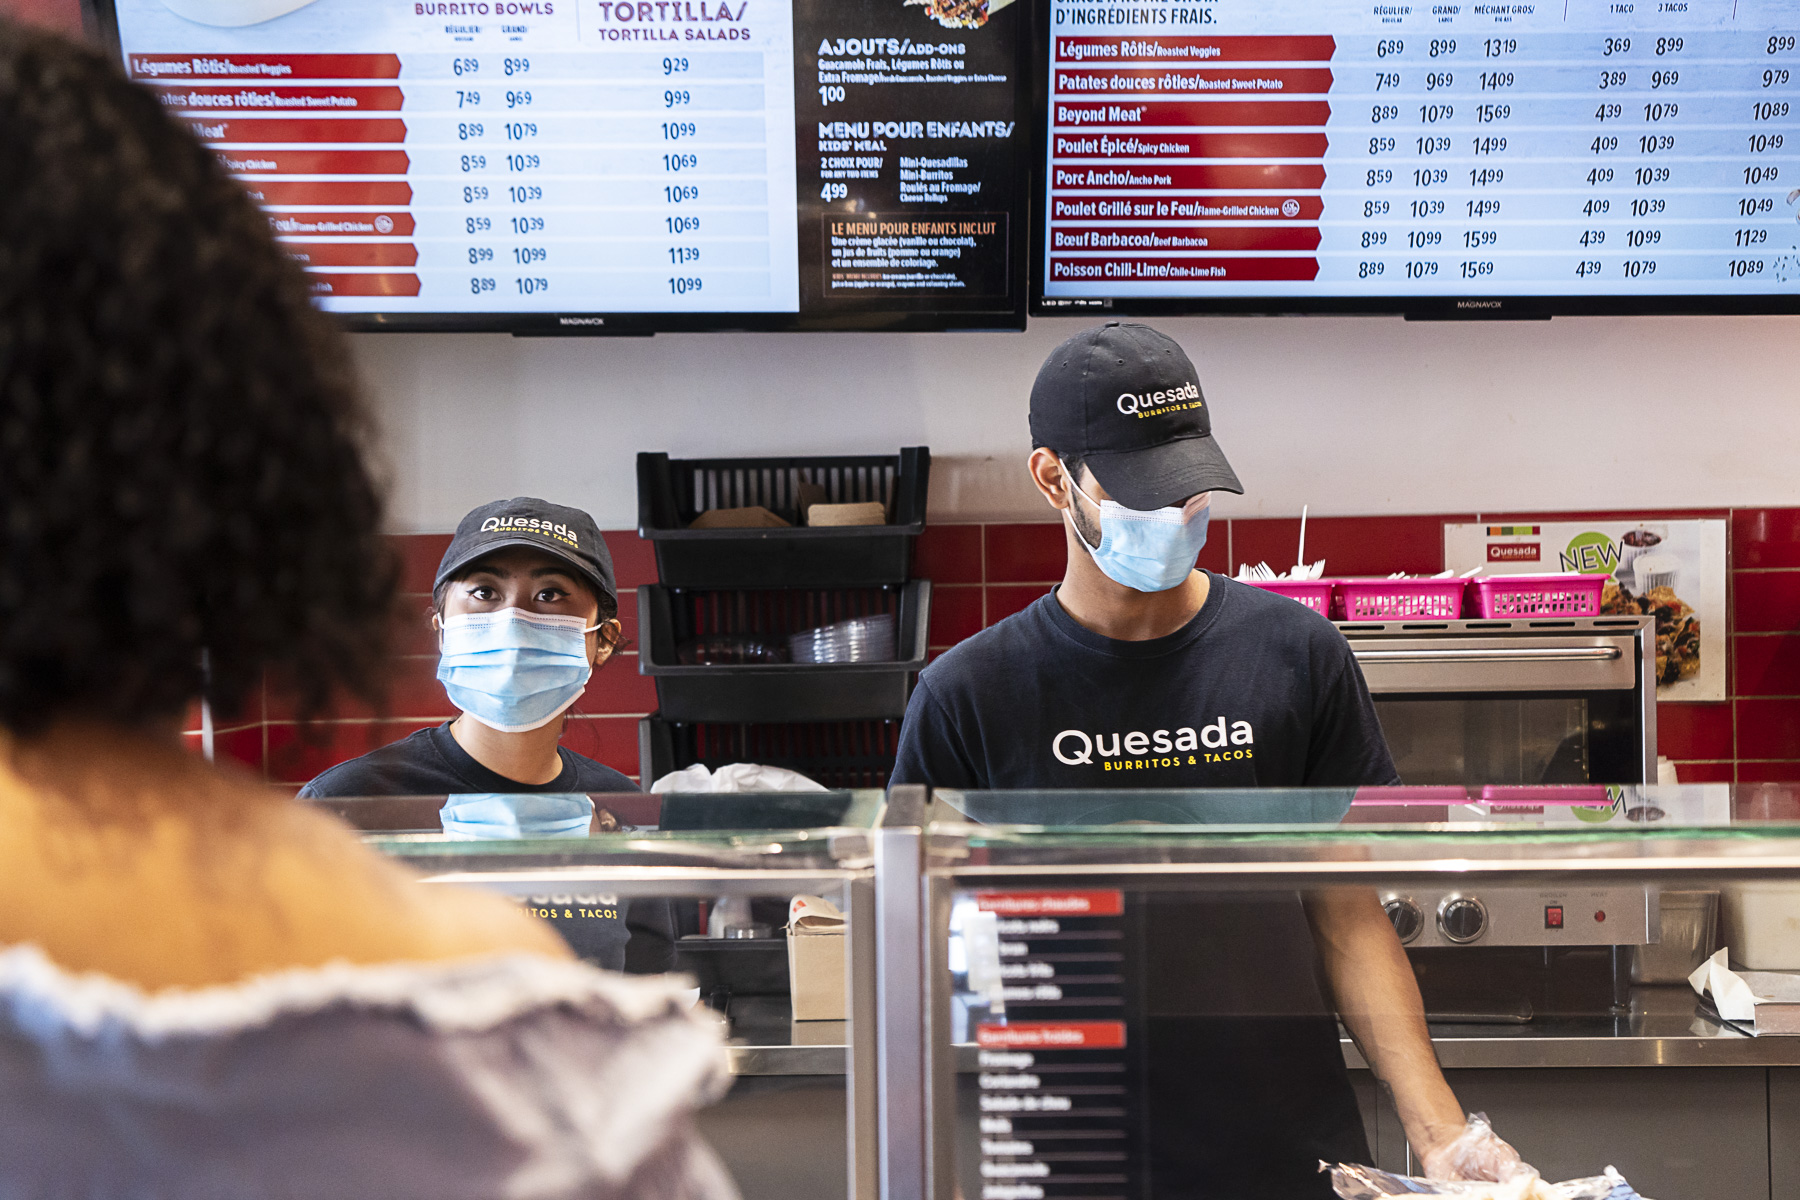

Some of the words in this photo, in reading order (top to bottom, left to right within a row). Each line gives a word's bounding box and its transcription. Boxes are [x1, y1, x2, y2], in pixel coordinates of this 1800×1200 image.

[415, 3, 489, 15] BURRITO
[495, 3, 554, 15] BOWLS
[599, 1, 748, 22] TORTILLA/
[1171, 8, 1217, 24] FRAIS.
[1474, 4, 1510, 14] MÉCHANT
[1615, 4, 1634, 13] TACO
[1658, 4, 1663, 12] 3
[1664, 3, 1688, 12] TACOS
[599, 29, 679, 41] TORTILLA
[685, 28, 750, 41] SALADS
[1059, 41, 1118, 60] Légumes
[1190, 46, 1221, 58] Veggies
[1377, 39, 1404, 58] 689
[1429, 39, 1457, 58] 899
[1483, 38, 1517, 58] 1319
[1603, 37, 1631, 56] 369
[1655, 37, 1684, 56] 899
[1766, 36, 1796, 55] 899
[453, 58, 479, 76] 689
[504, 58, 530, 76] 899
[663, 57, 689, 75] 929
[818, 58, 865, 71] Guacamole
[953, 60, 965, 70] ou
[818, 72, 841, 84] Extra
[1059, 74, 1108, 90] Patates
[1110, 74, 1156, 90] douces
[1231, 79, 1256, 89] Sweet
[1256, 79, 1284, 90] Potato
[1375, 73, 1400, 91] 749
[1426, 73, 1453, 91] 969
[1479, 72, 1514, 90] 1409
[1599, 70, 1627, 89] 389
[1651, 70, 1679, 89] 969
[1762, 69, 1789, 88] 979
[188, 91, 233, 106] douces
[456, 91, 481, 108] 749
[506, 91, 532, 108] 969
[664, 90, 690, 108] 999
[818, 85, 845, 106] 100
[1058, 106, 1106, 125] Beyond
[1371, 105, 1398, 123] 889
[1419, 105, 1454, 123] 1079
[1476, 104, 1511, 123] 1569
[1595, 103, 1622, 122] 439
[1643, 103, 1679, 122] 1079
[1752, 102, 1789, 121] 1089
[458, 123, 484, 140] 889
[505, 123, 537, 140] 1079
[661, 122, 696, 140] 1099
[818, 122, 869, 139] MENU
[873, 122, 924, 139] POUR
[854, 140, 887, 151] MEAL
[1057, 138, 1099, 154] Poulet
[1159, 143, 1190, 154] Chicken
[1590, 136, 1618, 155] 409
[1639, 135, 1675, 154] 1039
[1748, 134, 1784, 153] 1049
[820, 157, 827, 169] 2
[828, 157, 855, 169] CHOIX
[900, 169, 954, 181] Mini-Burritos
[1056, 170, 1085, 185] Porc
[1154, 175, 1172, 185] Pork
[820, 183, 848, 202] 499
[929, 184, 940, 193] au
[1055, 201, 1097, 216] Poulet
[1098, 200, 1132, 216] Grillé
[1134, 205, 1154, 216] sur
[1157, 201, 1169, 216] le
[1249, 206, 1279, 216] Chicken
[831, 222, 844, 235] LE
[846, 222, 877, 235] MENU
[880, 222, 909, 235] POUR
[912, 222, 957, 235] ENFANTS
[959, 222, 996, 235] INCLUT
[831, 236, 847, 246] Une
[928, 238, 938, 246] ou
[1172, 236, 1208, 247] Barbacoa
[1361, 231, 1387, 249] 899
[1407, 231, 1442, 248] 1099
[1463, 231, 1497, 248] 1599
[1579, 230, 1606, 248] 439
[1626, 230, 1662, 247] 1099
[1734, 229, 1767, 247] 1129
[831, 249, 842, 257] un
[842, 248, 854, 258] jus
[855, 248, 866, 257] de
[867, 248, 887, 257] fruits
[920, 249, 930, 257] ou
[831, 258, 840, 267] et
[841, 259, 851, 267] un
[852, 258, 889, 267] ensemble
[890, 258, 900, 267] de
[1054, 262, 1102, 277] Poisson
[1210, 267, 1226, 277] Fish
[1358, 261, 1385, 279] 889
[1405, 261, 1439, 278] 1079
[1460, 261, 1494, 278] 1569
[1575, 261, 1602, 278] 439
[1622, 261, 1657, 278] 1079
[1728, 260, 1764, 278] 1089
[471, 278, 496, 294] 889
[515, 278, 548, 294] 1079
[668, 278, 702, 294] 1099
[1457, 301, 1502, 309] MAGNAVOX
[1117, 382, 1200, 415] Quesada
[1138, 406, 1181, 419] BURRITOS
[480, 517, 578, 542] Quesada
[553, 533, 579, 549] TACOS
[1490, 546, 1537, 558] Quesada
[1559, 540, 1624, 573] NEW
[1052, 716, 1254, 766] Quesada
[1104, 756, 1180, 771] BURRITOS
[1188, 755, 1197, 765] &
[1204, 749, 1253, 763] TACOS
[564, 909, 573, 919] &
[579, 908, 617, 920] TACOS
